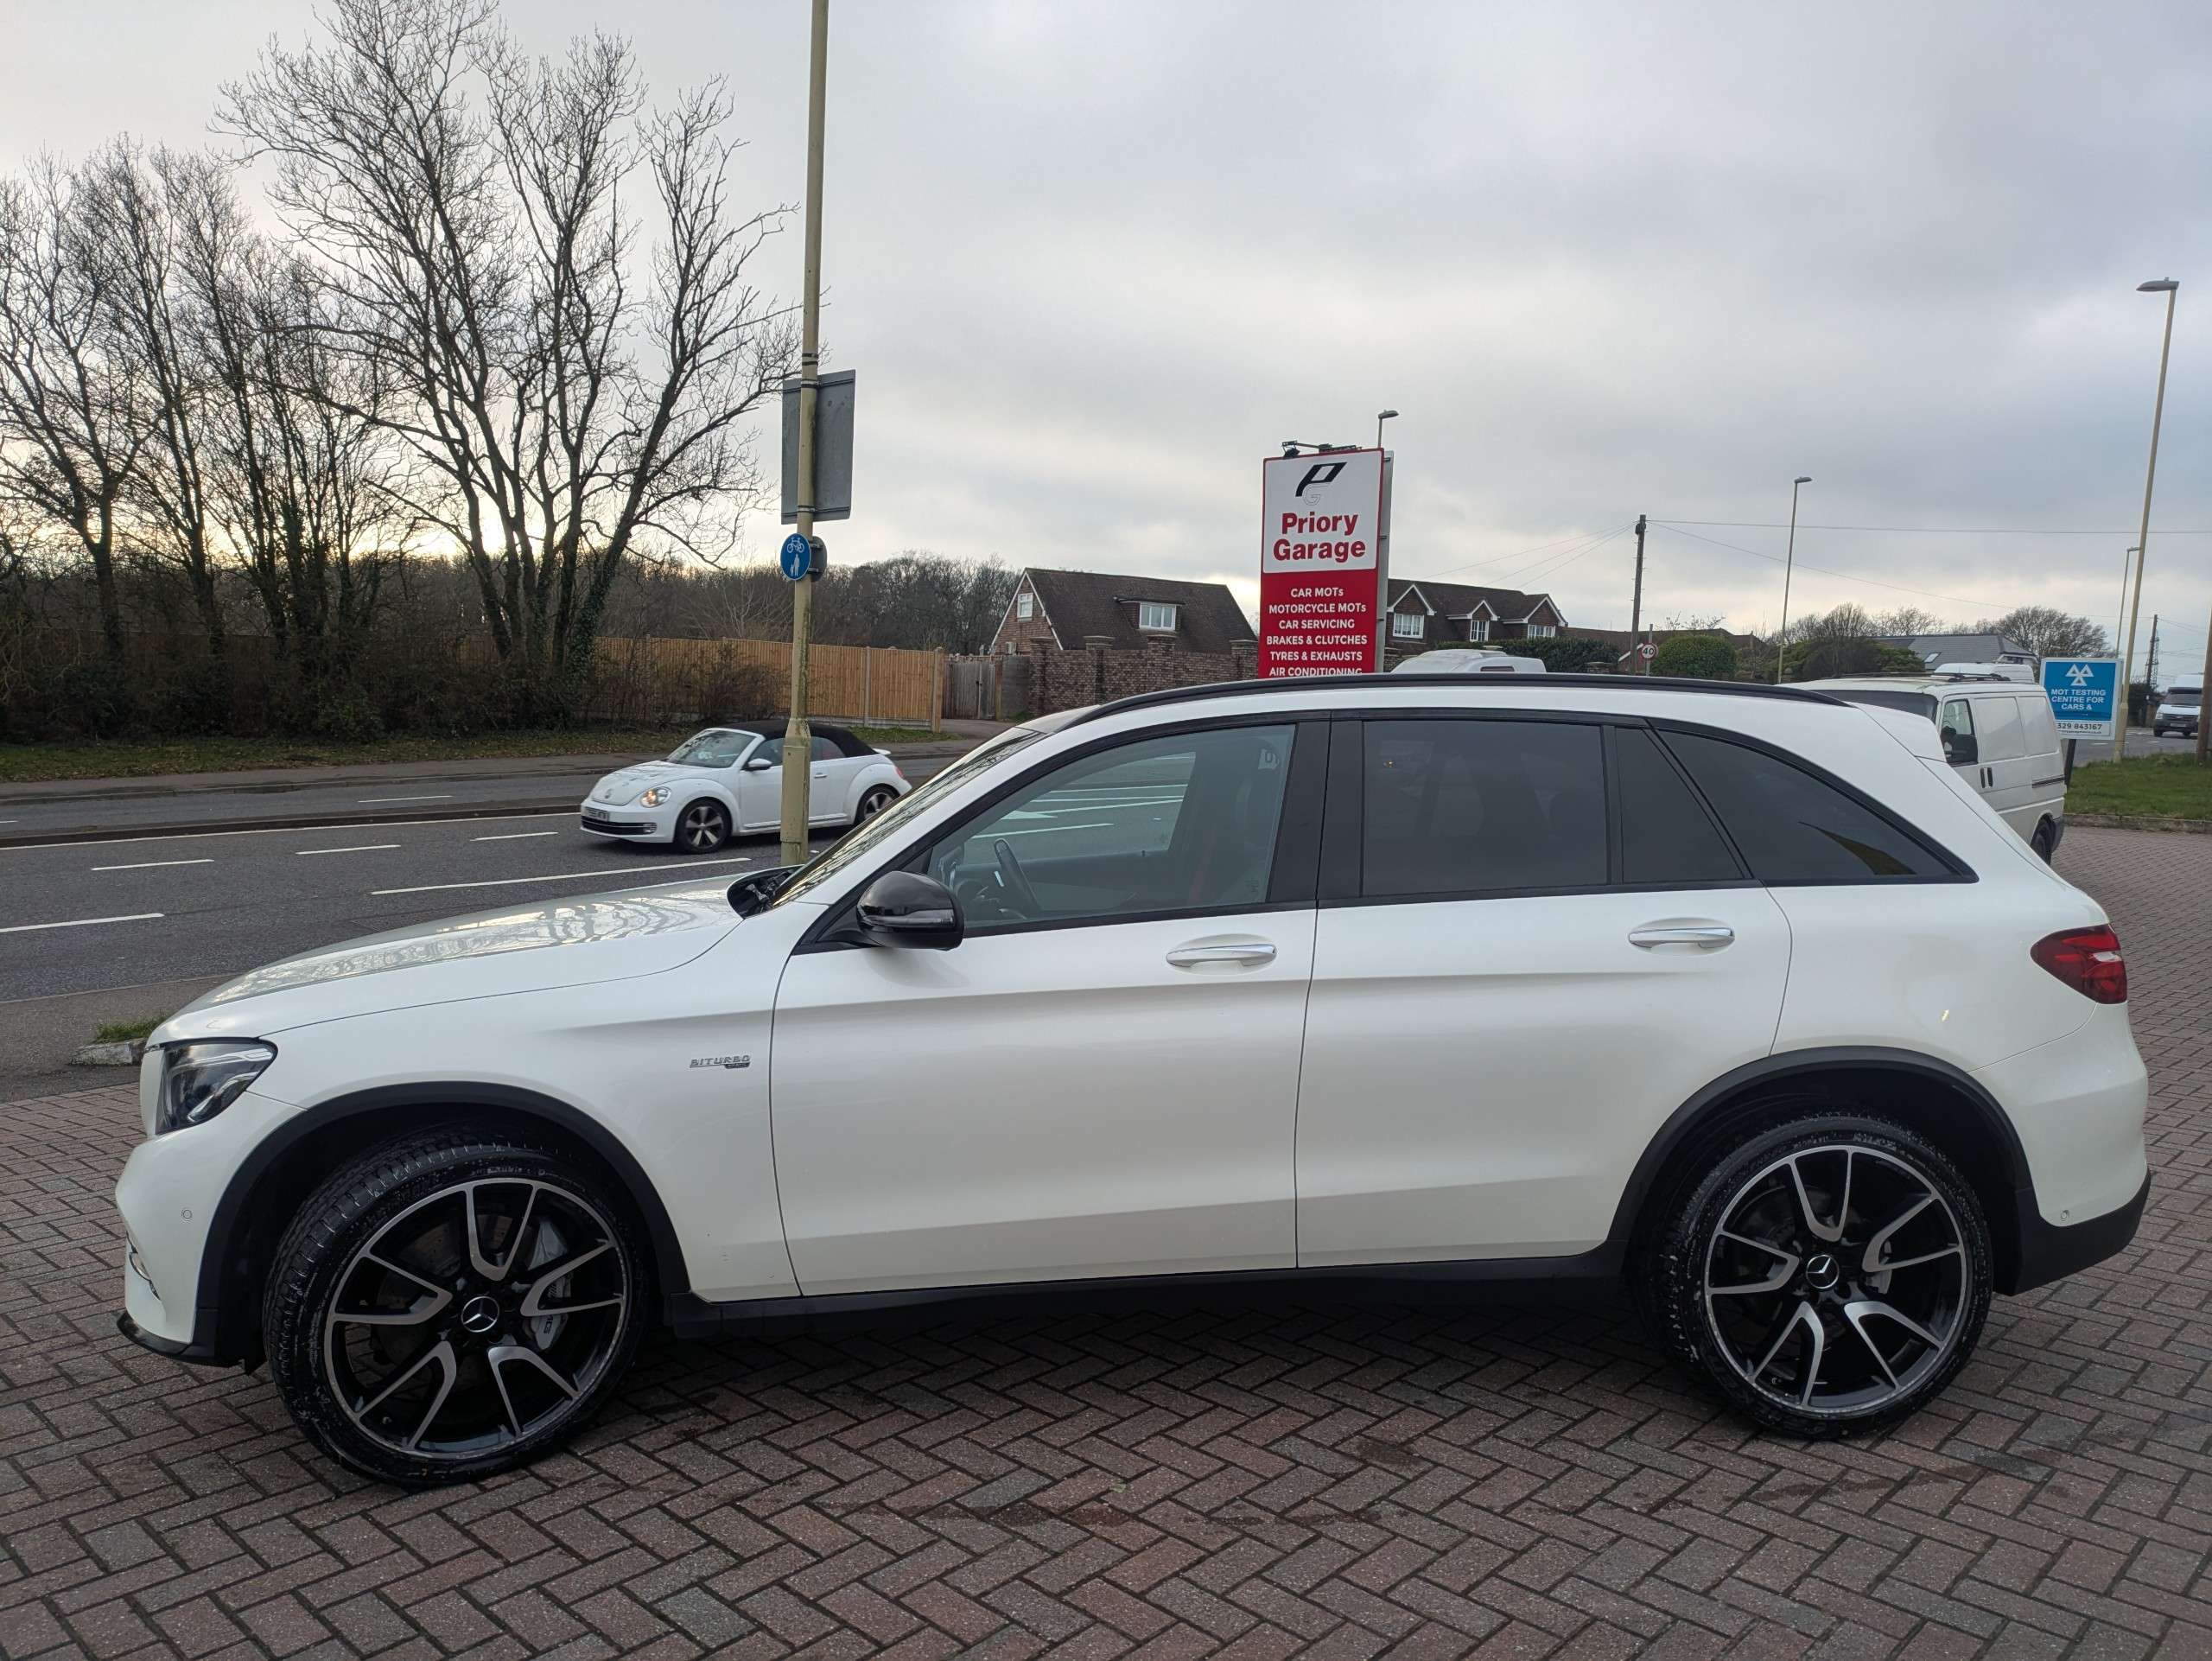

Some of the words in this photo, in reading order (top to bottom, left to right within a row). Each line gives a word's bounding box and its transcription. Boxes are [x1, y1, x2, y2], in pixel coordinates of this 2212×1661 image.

[1281, 512, 1358, 536] Priory
[1274, 538, 1366, 563] Garage
[1291, 588, 1312, 598] CAR
[1315, 588, 1344, 597] MOTs
[1269, 603, 1335, 614] MOTORCYCLE
[1338, 603, 1366, 613] MOTs
[1279, 620, 1299, 629] CAR
[1301, 619, 1355, 629] SERVICING
[1267, 635, 1304, 646] BRAKES
[1306, 635, 1313, 645] &
[1315, 635, 1367, 645] CLUTCHES
[1270, 652, 1299, 661] TYRES
[1301, 652, 1308, 661] &
[1310, 652, 1363, 661] EXHAUSTS
[1269, 667, 1286, 677] AIR
[690, 1055, 750, 1066] BITURBO
